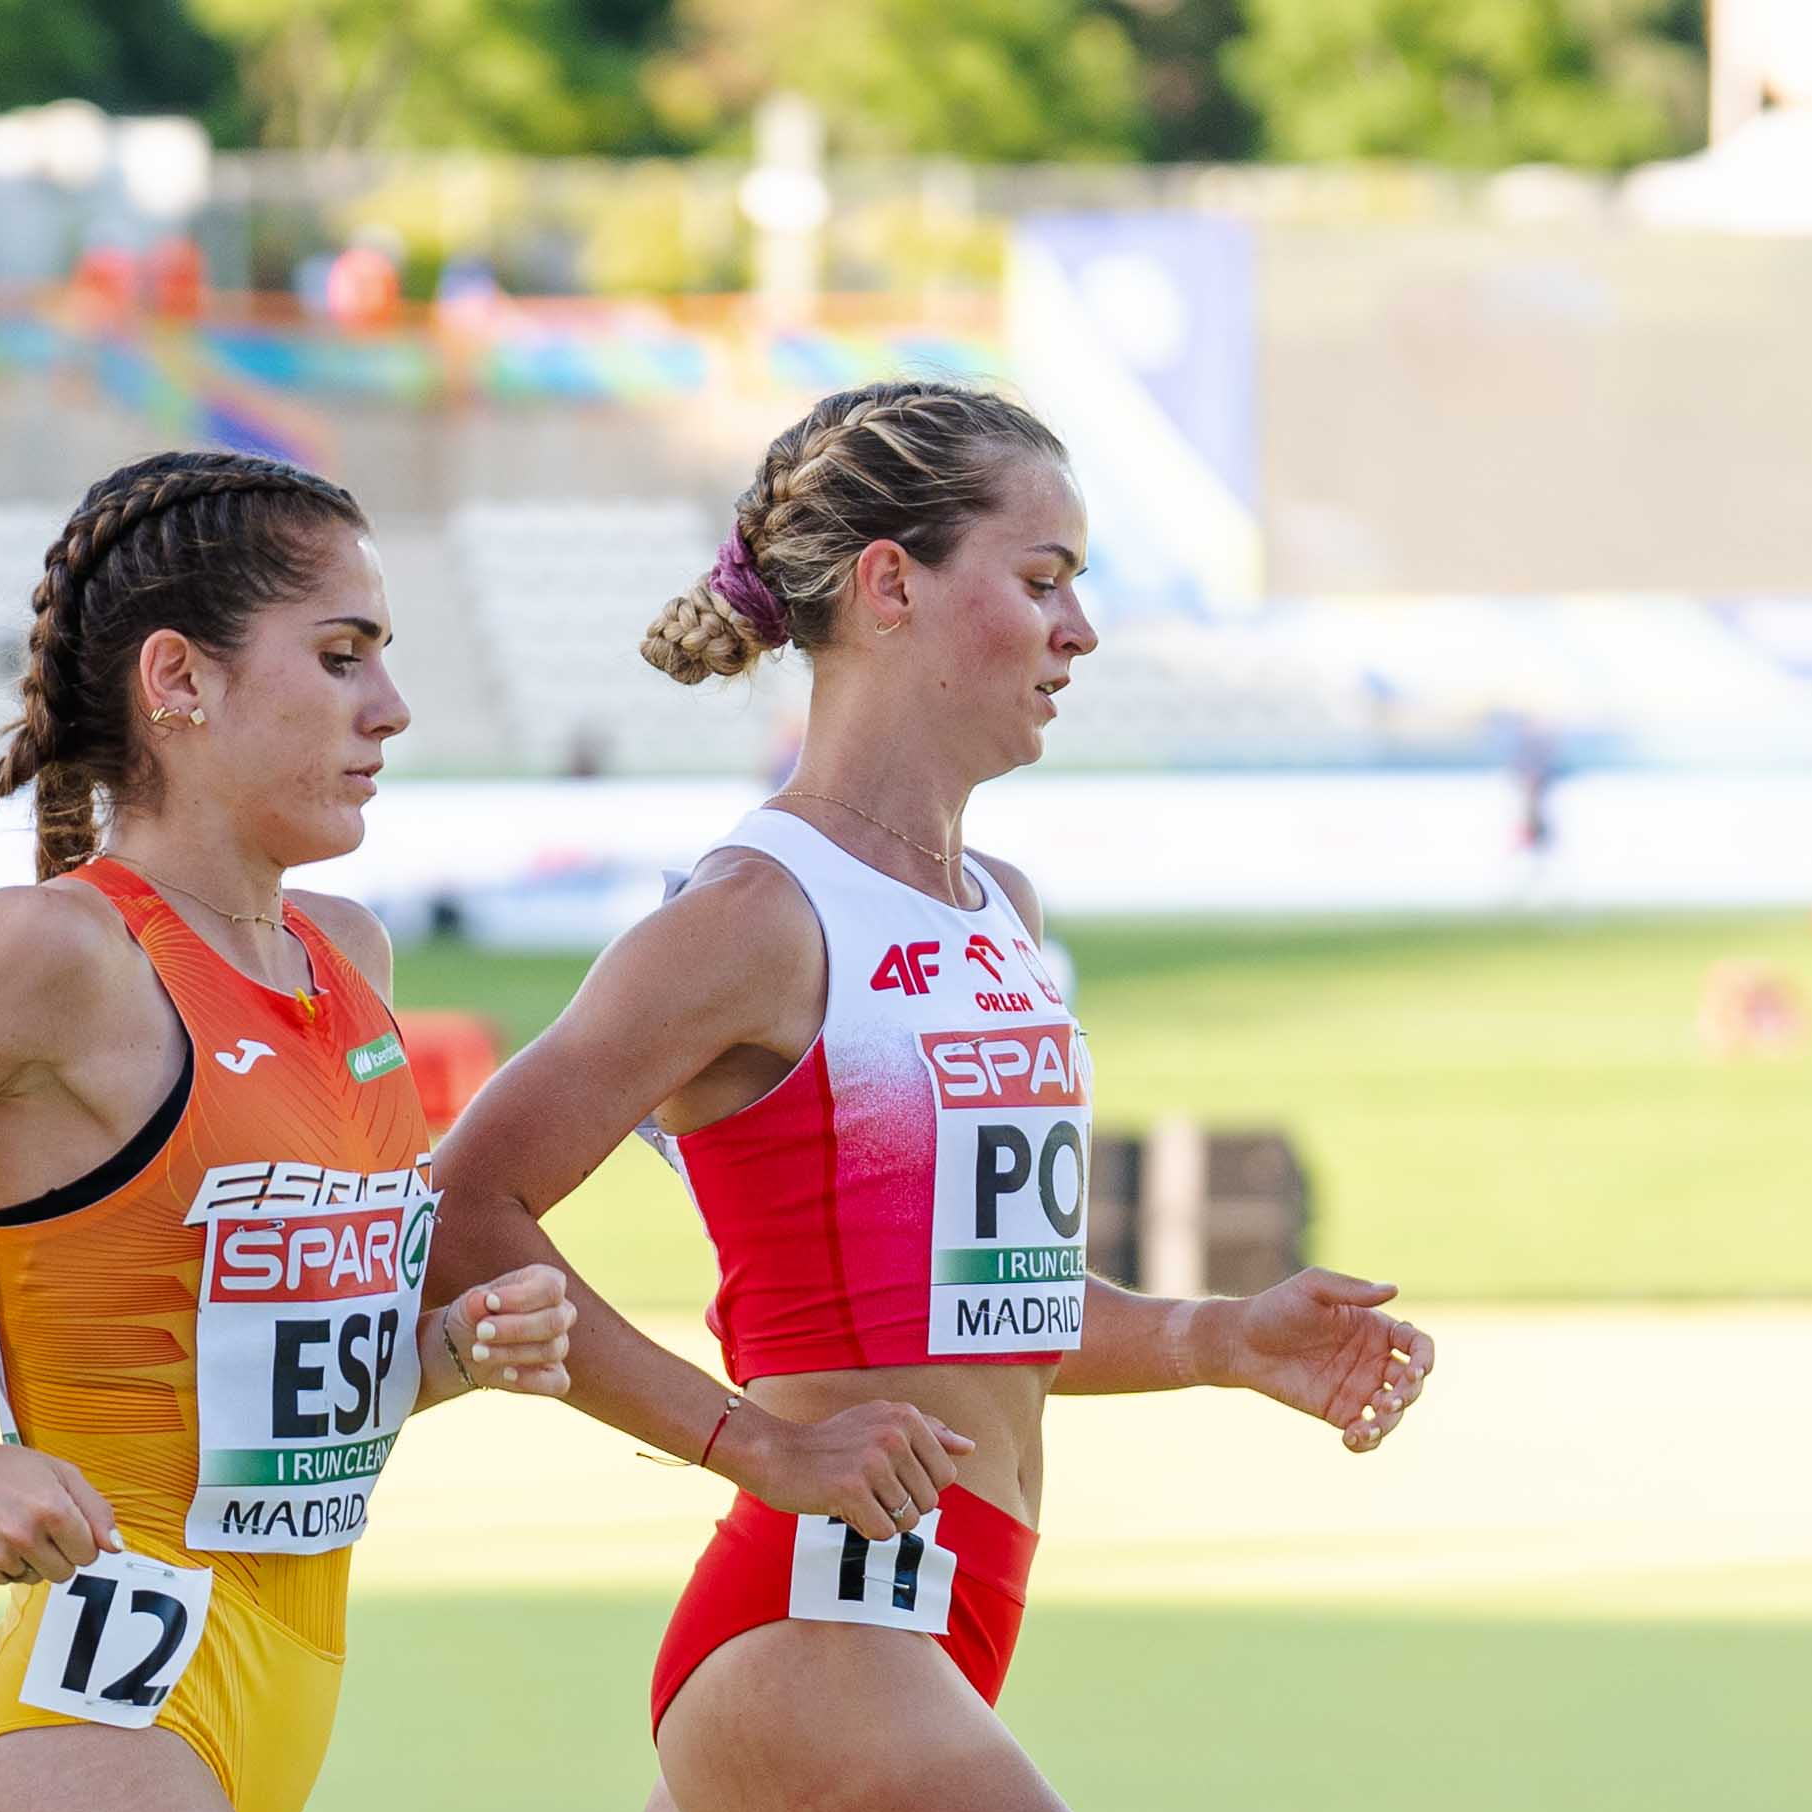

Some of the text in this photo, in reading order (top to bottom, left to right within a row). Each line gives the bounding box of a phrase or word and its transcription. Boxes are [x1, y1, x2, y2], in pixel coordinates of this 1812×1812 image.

[869, 941, 940, 996] 4F
[975, 992, 1034, 1012] ORLEN
[220, 1220, 396, 1291] SPAR
[998, 1253, 1004, 1279] I
[1011, 1251, 1057, 1278] RUN
[957, 1295, 1082, 1336] MADRID
[272, 1308, 399, 1439] ESP
[277, 1453, 285, 1481] I
[293, 1450, 343, 1480] RUN
[60, 1573, 188, 1707] 12
